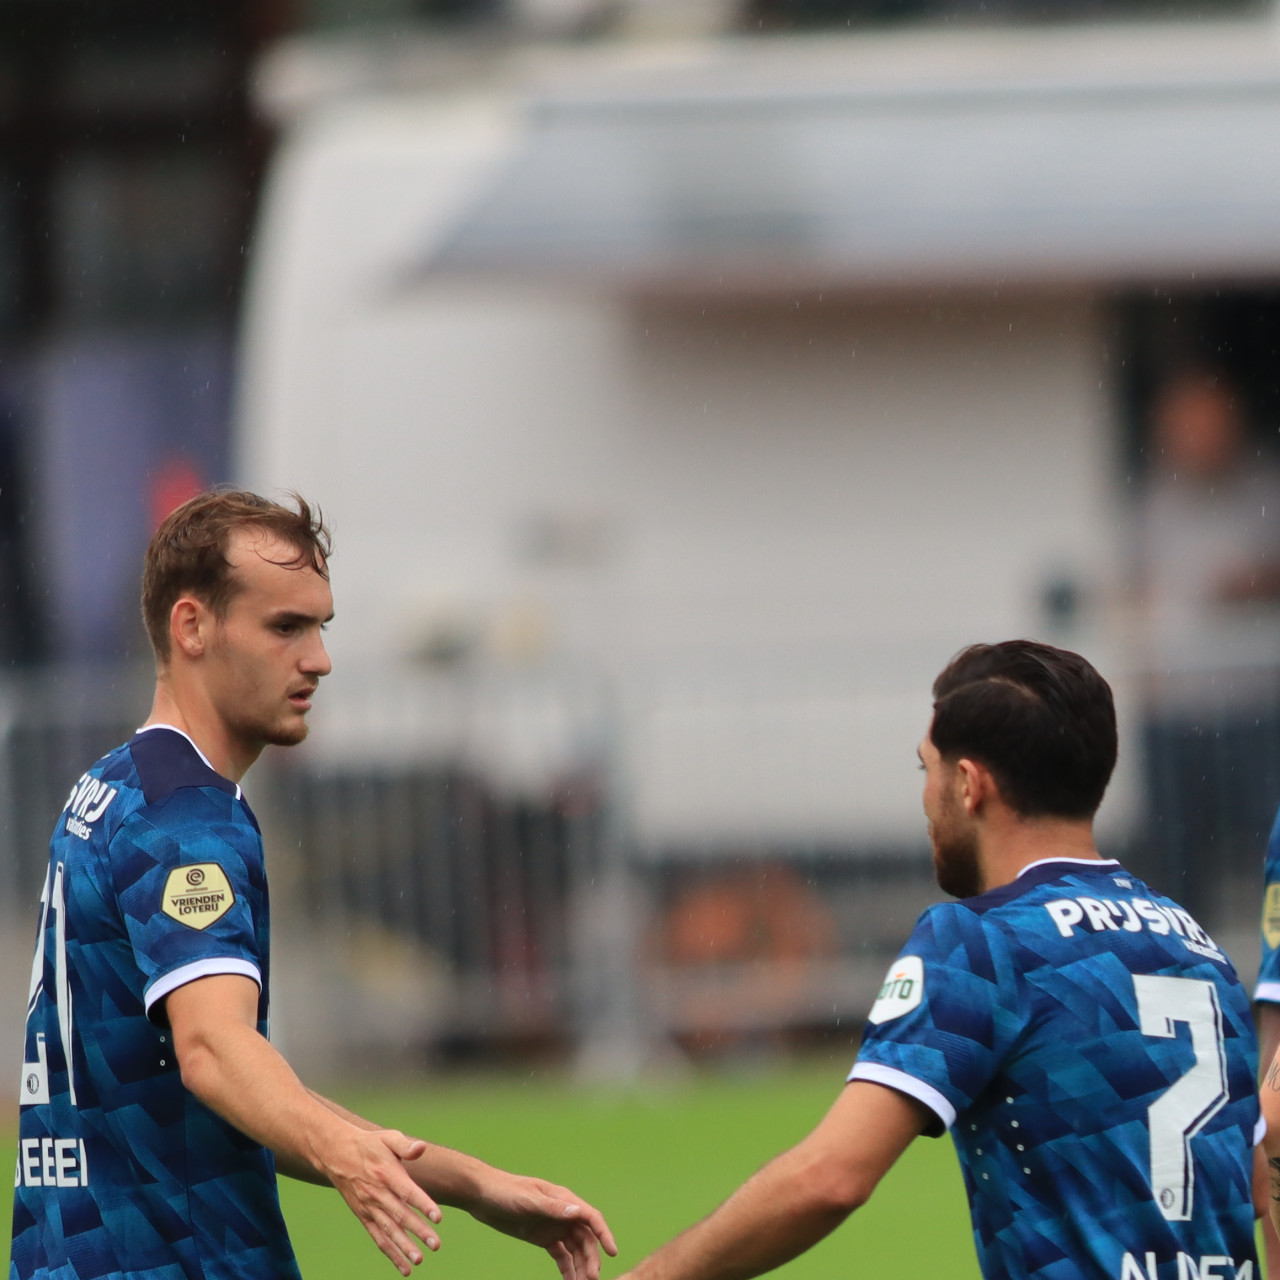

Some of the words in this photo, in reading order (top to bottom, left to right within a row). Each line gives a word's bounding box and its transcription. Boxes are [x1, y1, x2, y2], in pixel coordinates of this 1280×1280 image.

[171, 893, 225, 907] VRIENDEN
[178, 902, 219, 916] LOTERIJ
[1131, 973, 1230, 1221] 7
